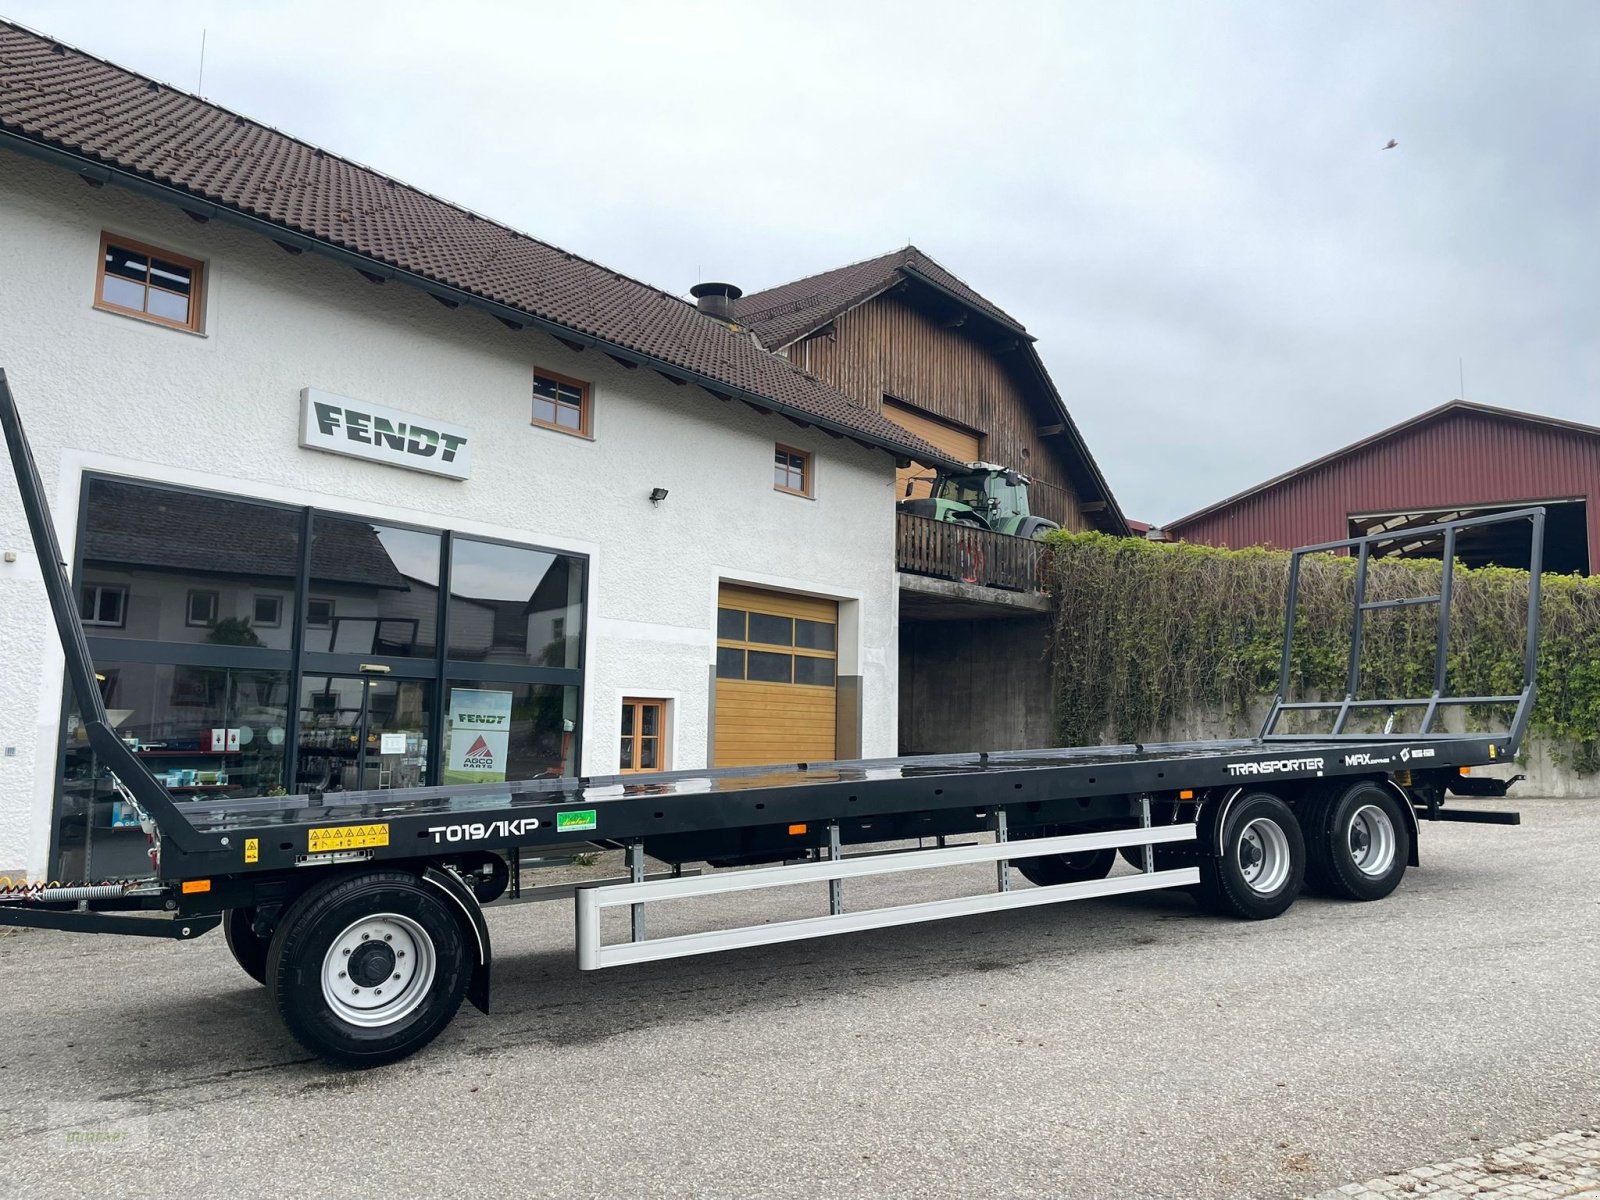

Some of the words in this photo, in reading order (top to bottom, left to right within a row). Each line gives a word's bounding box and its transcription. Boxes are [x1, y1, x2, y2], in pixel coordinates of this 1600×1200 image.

[313, 401, 468, 463] FENDT
[458, 713, 506, 725] FENDT
[1227, 757, 1325, 776] TRANSPORTER
[1344, 753, 1371, 767] MAX
[428, 818, 539, 844] T019/1KP
